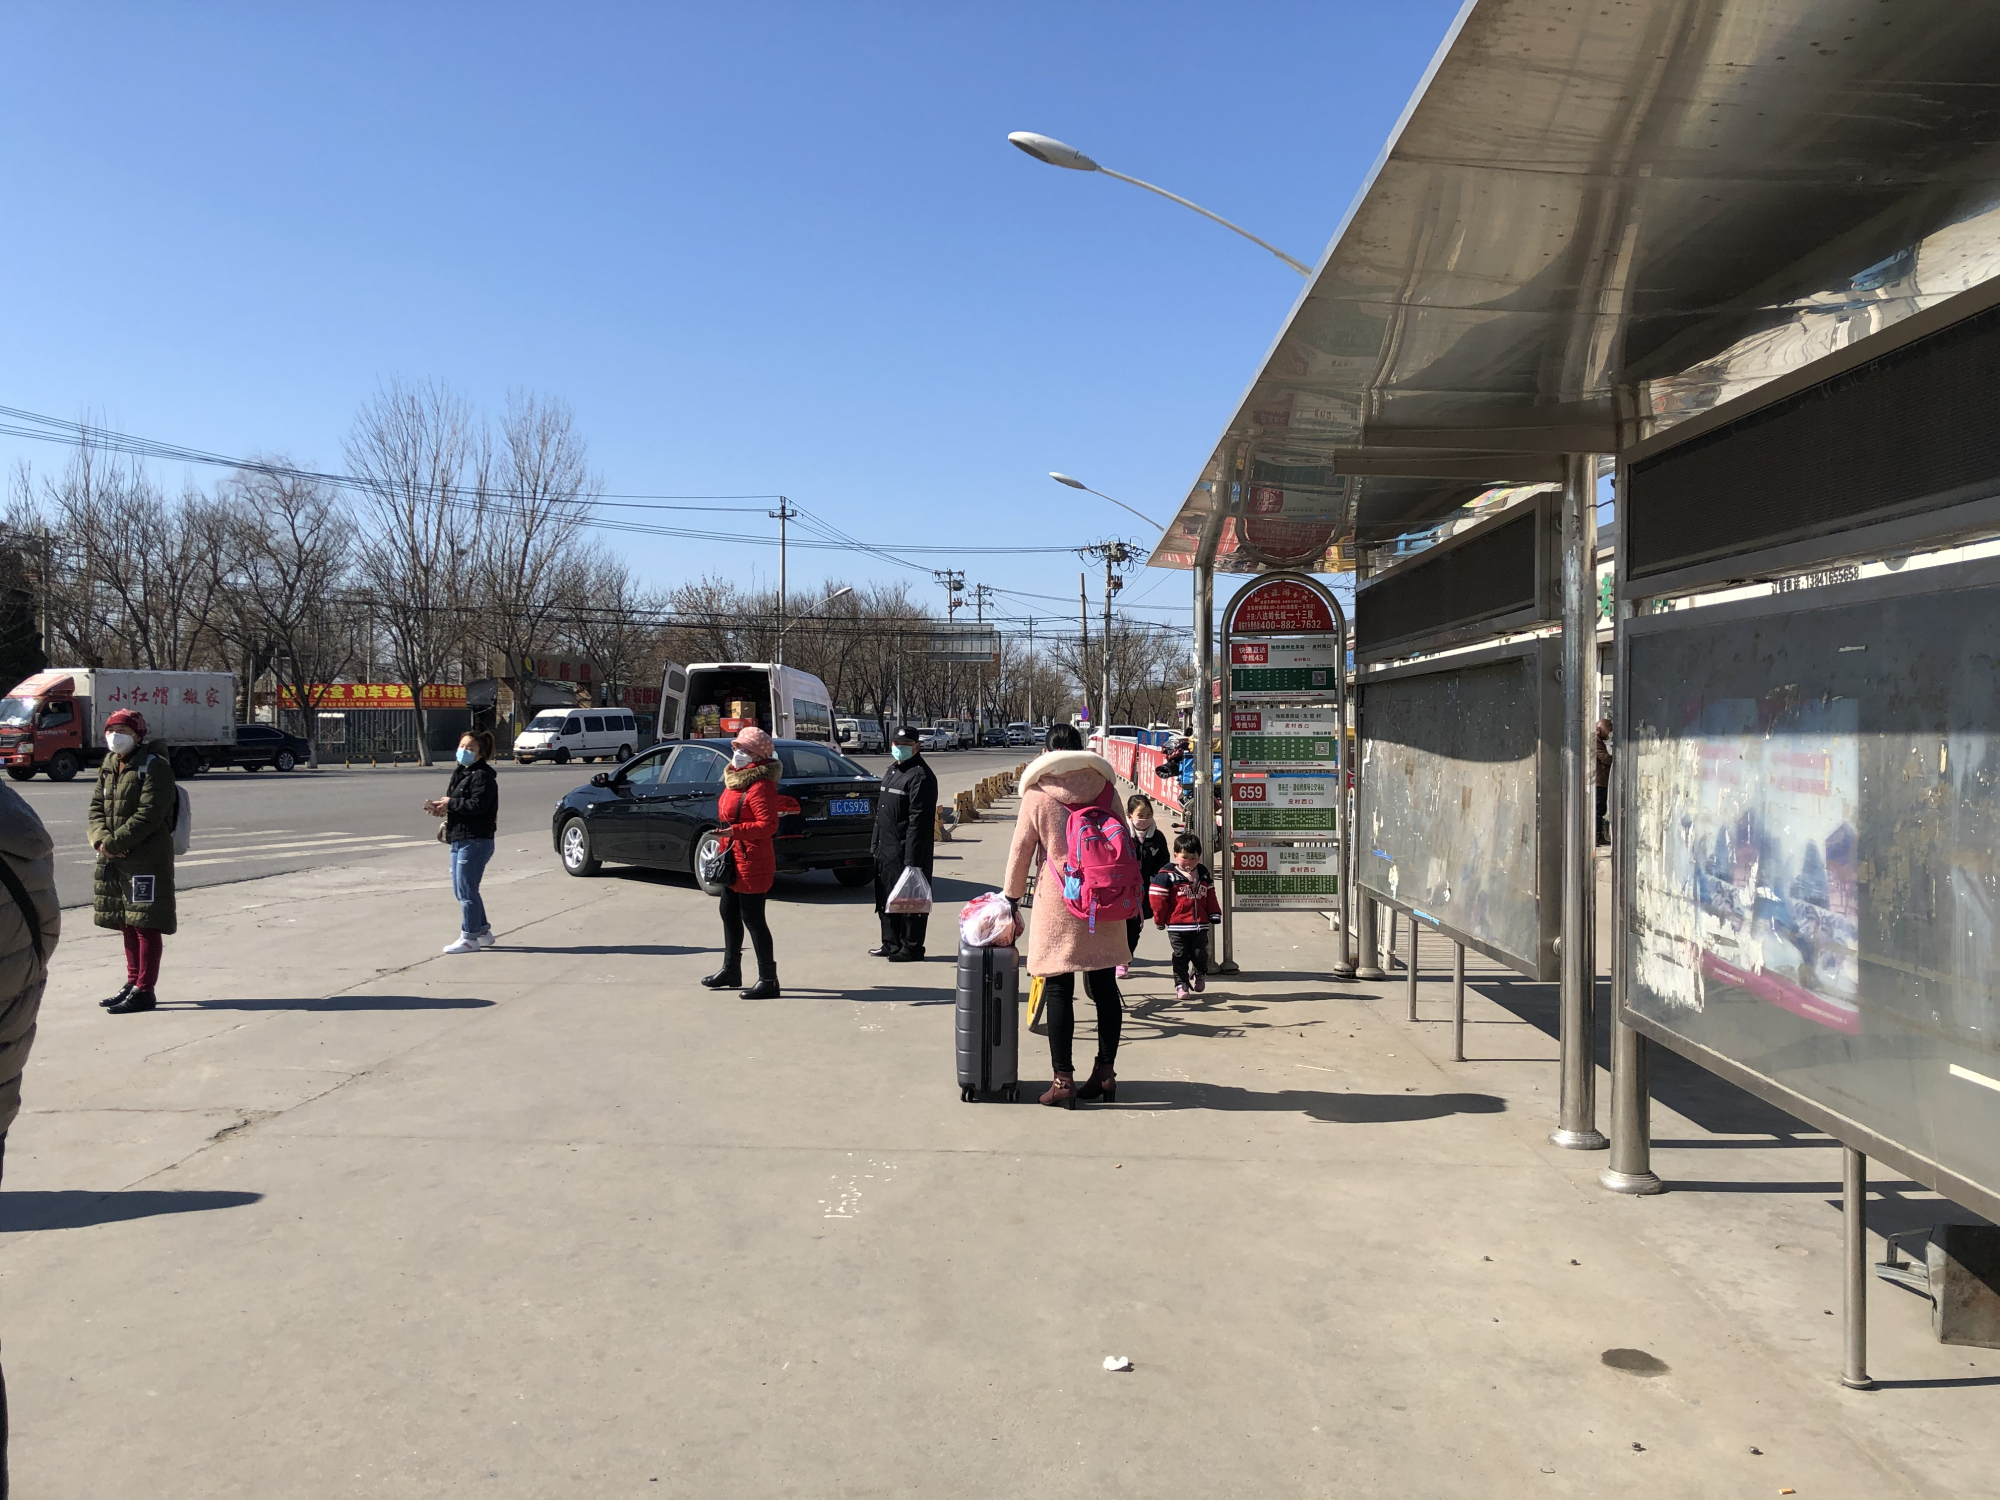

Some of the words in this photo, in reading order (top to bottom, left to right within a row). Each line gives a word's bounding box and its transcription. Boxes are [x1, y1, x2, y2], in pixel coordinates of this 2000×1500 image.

[108, 685, 170, 706] 小红帽
[182, 687, 220, 707] 搬家
[1239, 786, 1262, 799] 659
[1240, 854, 1264, 868] 989
